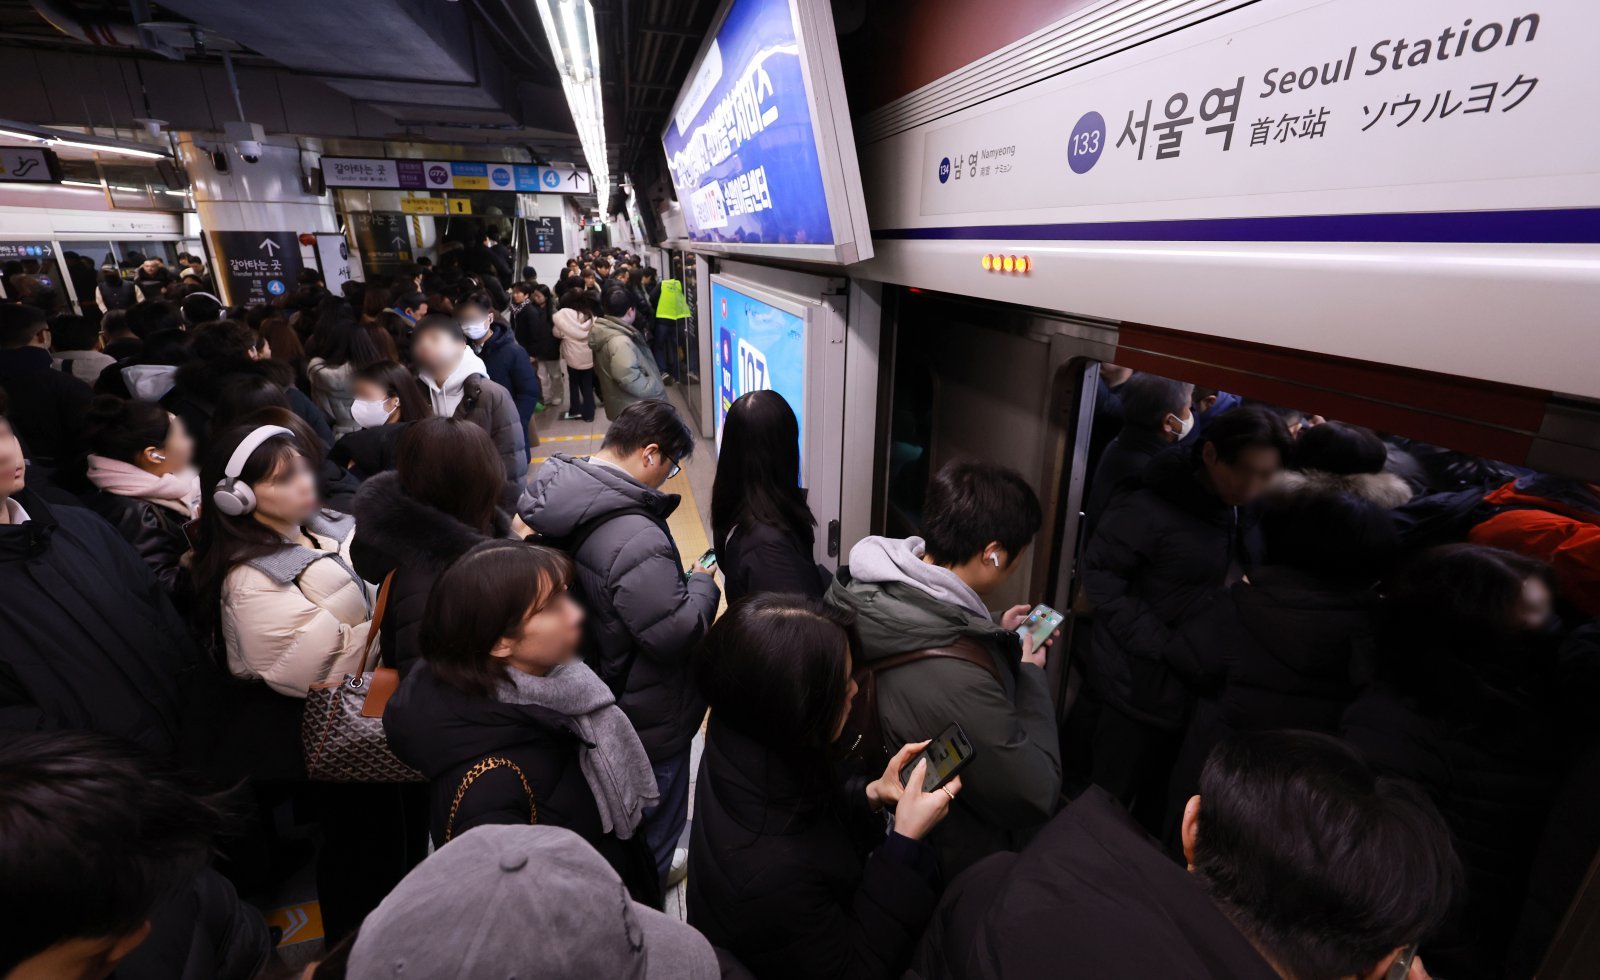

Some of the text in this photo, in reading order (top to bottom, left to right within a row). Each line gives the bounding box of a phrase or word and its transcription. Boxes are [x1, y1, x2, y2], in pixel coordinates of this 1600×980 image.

[1259, 12, 1541, 99] Seoul Station
[1361, 74, 1539, 132] ソウルヨク
[1115, 76, 1245, 161] 서울역
[1249, 106, 1330, 147] 首尔站
[980, 145, 1016, 160] Namyeong
[1072, 129, 1101, 156] 133
[333, 163, 374, 176] 갈아타는
[375, 164, 386, 176] 곳
[429, 169, 446, 177] GTX
[545, 172, 556, 186] 4
[230, 259, 282, 272] 갈아타는 곳
[271, 281, 281, 293] 4
[741, 346, 764, 394] 107
